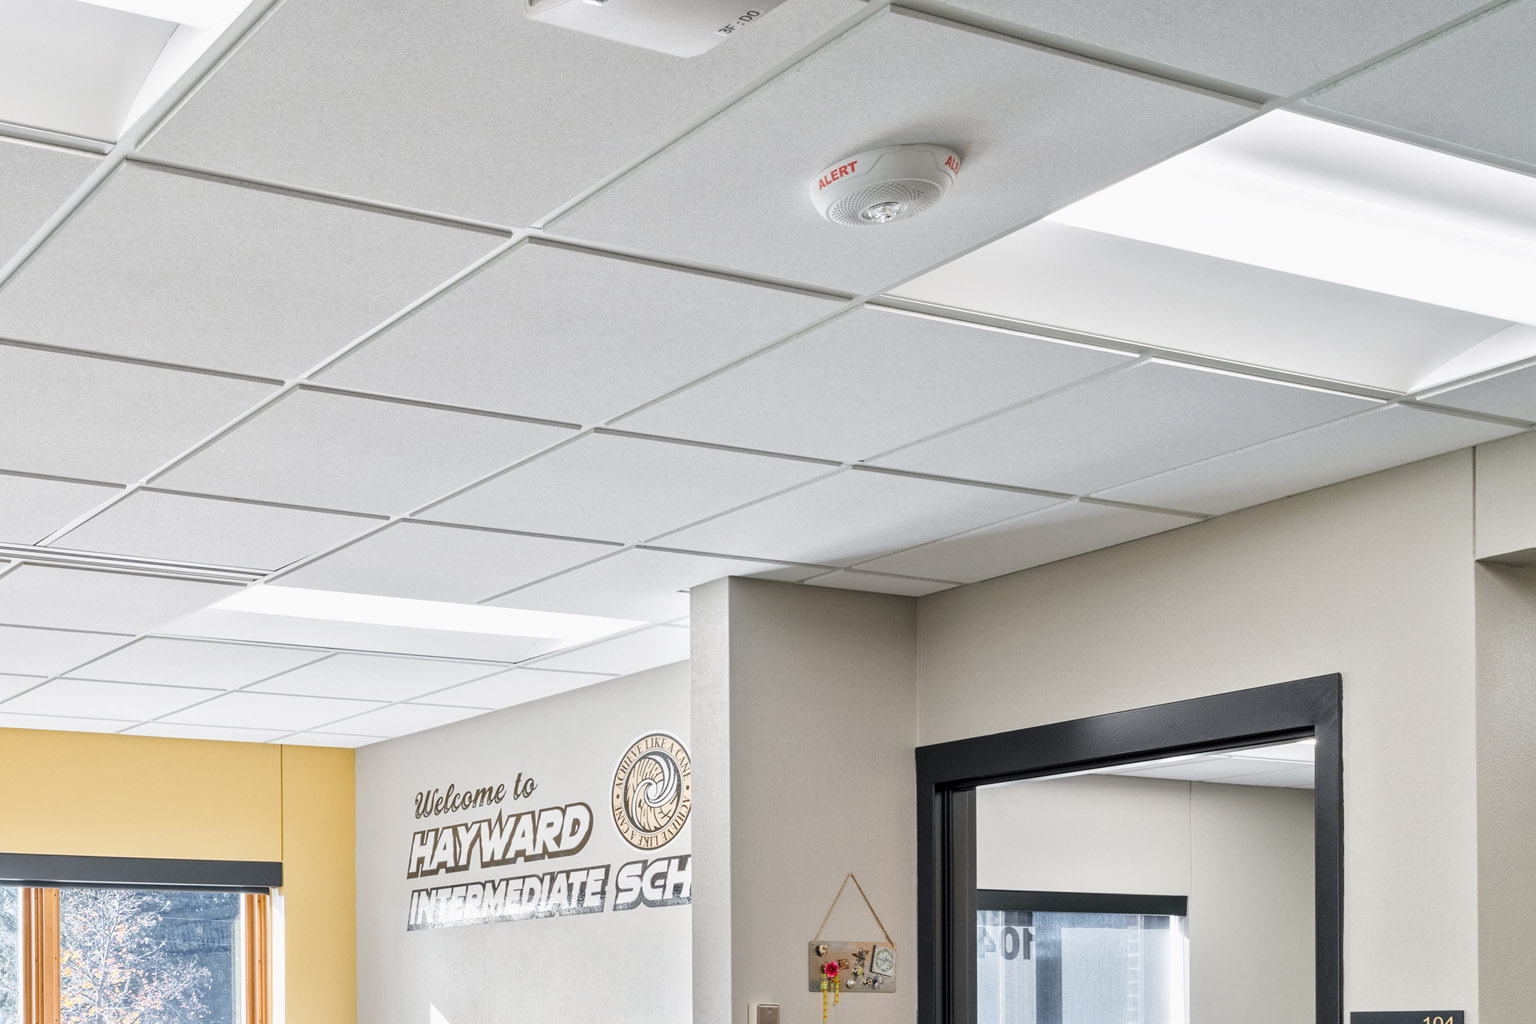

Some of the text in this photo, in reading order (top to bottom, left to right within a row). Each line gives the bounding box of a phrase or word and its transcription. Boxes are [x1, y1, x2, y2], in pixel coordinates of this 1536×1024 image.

[818, 160, 858, 191] ALERT
[615, 737, 692, 790] ACHIEVE LIKE A CANE
[415, 772, 538, 820] Welcome to
[614, 803, 629, 834] CANE
[662, 795, 691, 844] ACHIEVE
[407, 802, 594, 880] HAYWARD
[638, 835, 659, 848] LIKE
[407, 864, 611, 931] INTERMEDIATE
